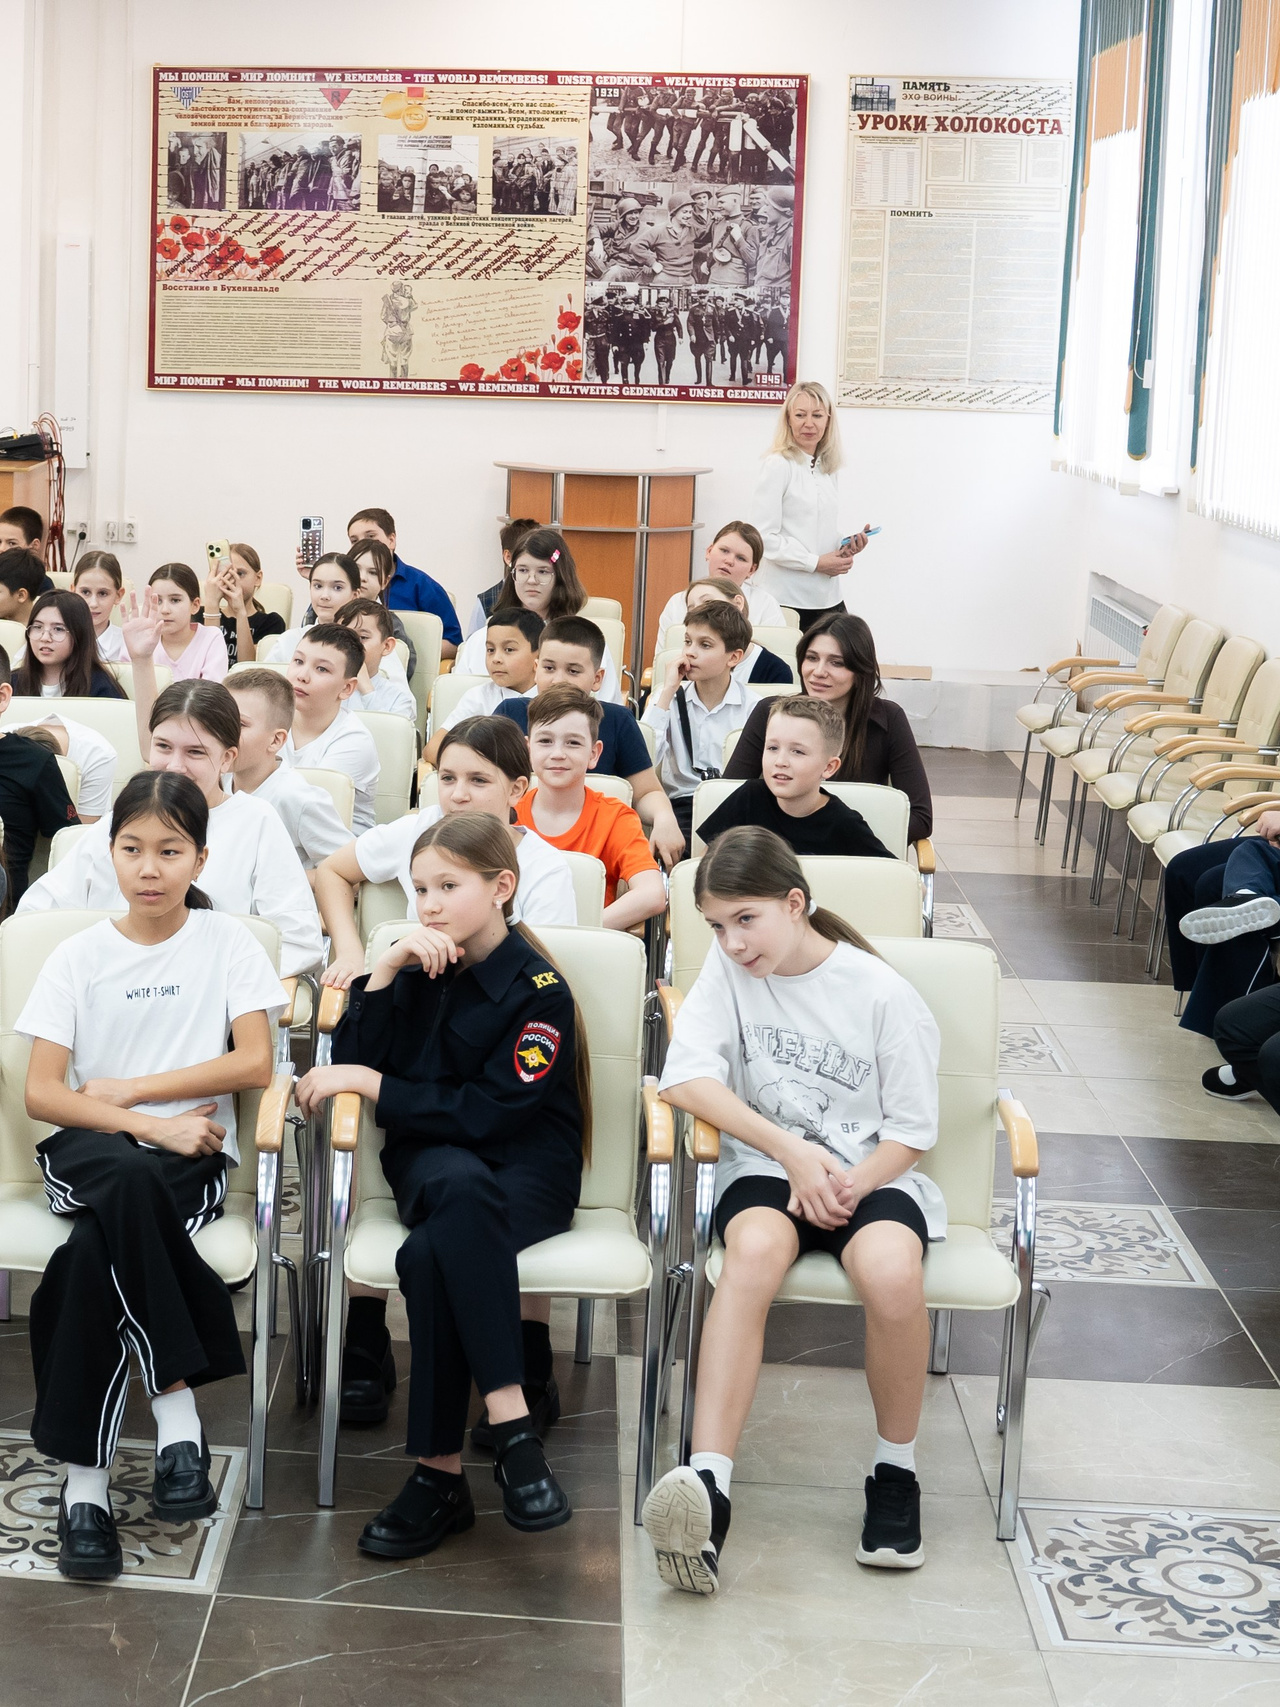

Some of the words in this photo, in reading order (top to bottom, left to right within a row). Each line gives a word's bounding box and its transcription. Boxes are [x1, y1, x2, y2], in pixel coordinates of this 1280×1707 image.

[159, 72, 179, 82] МЫ
[182, 72, 230, 82] ПОМНИМ
[240, 72, 264, 82] МИР
[266, 72, 316, 82] ПОМНИТ!
[324, 73, 342, 82] WE
[344, 73, 402, 83] REMEMBER
[414, 74, 435, 83] THE
[437, 74, 477, 84] WORLD
[479, 74, 548, 84] REMEMBERS!
[557, 75, 593, 85] UNSER
[595, 76, 653, 86] GEDENKEN
[663, 76, 737, 87] WELTWEITES
[738, 77, 800, 88] GEDENKEN!
[594, 87, 620, 97] 1939
[902, 80, 951, 93] ПАМЯТЬ
[902, 93, 920, 101] ЭХО
[923, 92, 958, 102] ВОЙНЫ
[857, 113, 928, 132] УРОКИ
[933, 116, 1064, 135] ХОЛОКОСТА
[890, 209, 933, 218] ПОМНИТЬ
[162, 283, 210, 293] Восстание
[220, 284, 280, 294] Бухенвальде
[154, 376, 178, 386] МИР
[180, 376, 225, 387] ПОМНИТ
[235, 378, 255, 387] МЫ
[258, 378, 310, 388] ПОМНИМ!
[755, 374, 781, 384] 1945
[318, 379, 339, 389] THE
[340, 380, 380, 390] WORLD
[382, 381, 447, 391] REMEMBERS
[458, 383, 476, 392] WE
[478, 383, 540, 393] REMEMBER!
[548, 385, 620, 396] WELTWEITES
[622, 386, 678, 397] GEDENKEN
[689, 388, 725, 398] UNSER
[726, 389, 787, 400] GEDENKEN!
[532, 971, 559, 989] КК
[153, 985, 181, 997] T-SHIRT
[527, 1022, 560, 1038] ПОЛИЦИЯ
[521, 1033, 556, 1053] РОССИЯ
